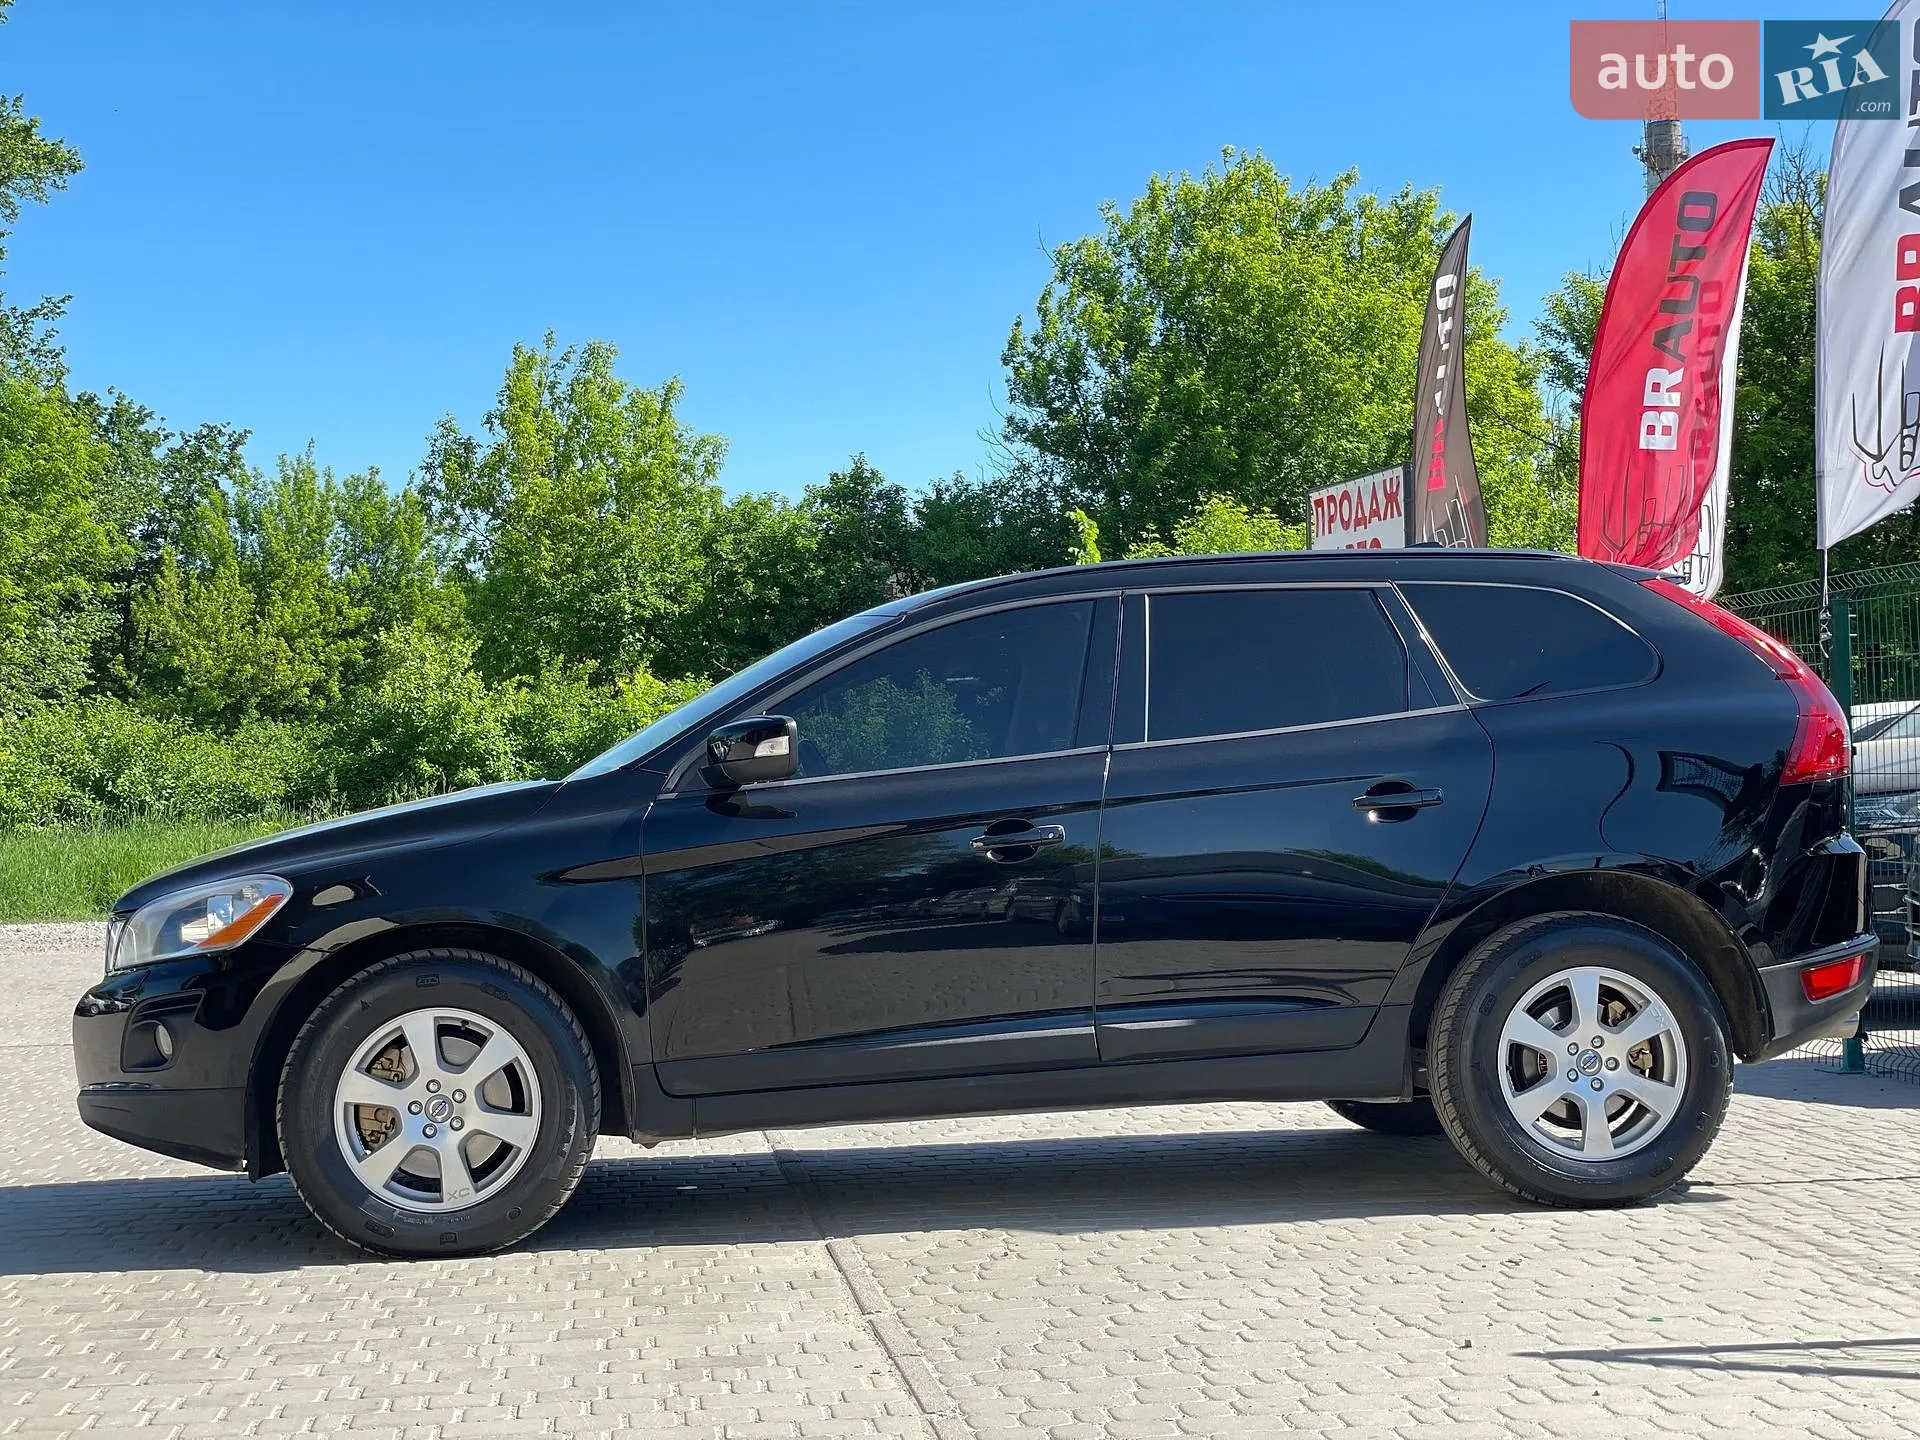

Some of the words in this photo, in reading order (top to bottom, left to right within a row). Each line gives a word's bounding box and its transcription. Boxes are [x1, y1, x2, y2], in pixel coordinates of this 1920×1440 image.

[1638, 190, 1719, 451] BRAUTO
[1313, 475, 1402, 538] ПРОДАЖ
[447, 1187, 470, 1202] XC
